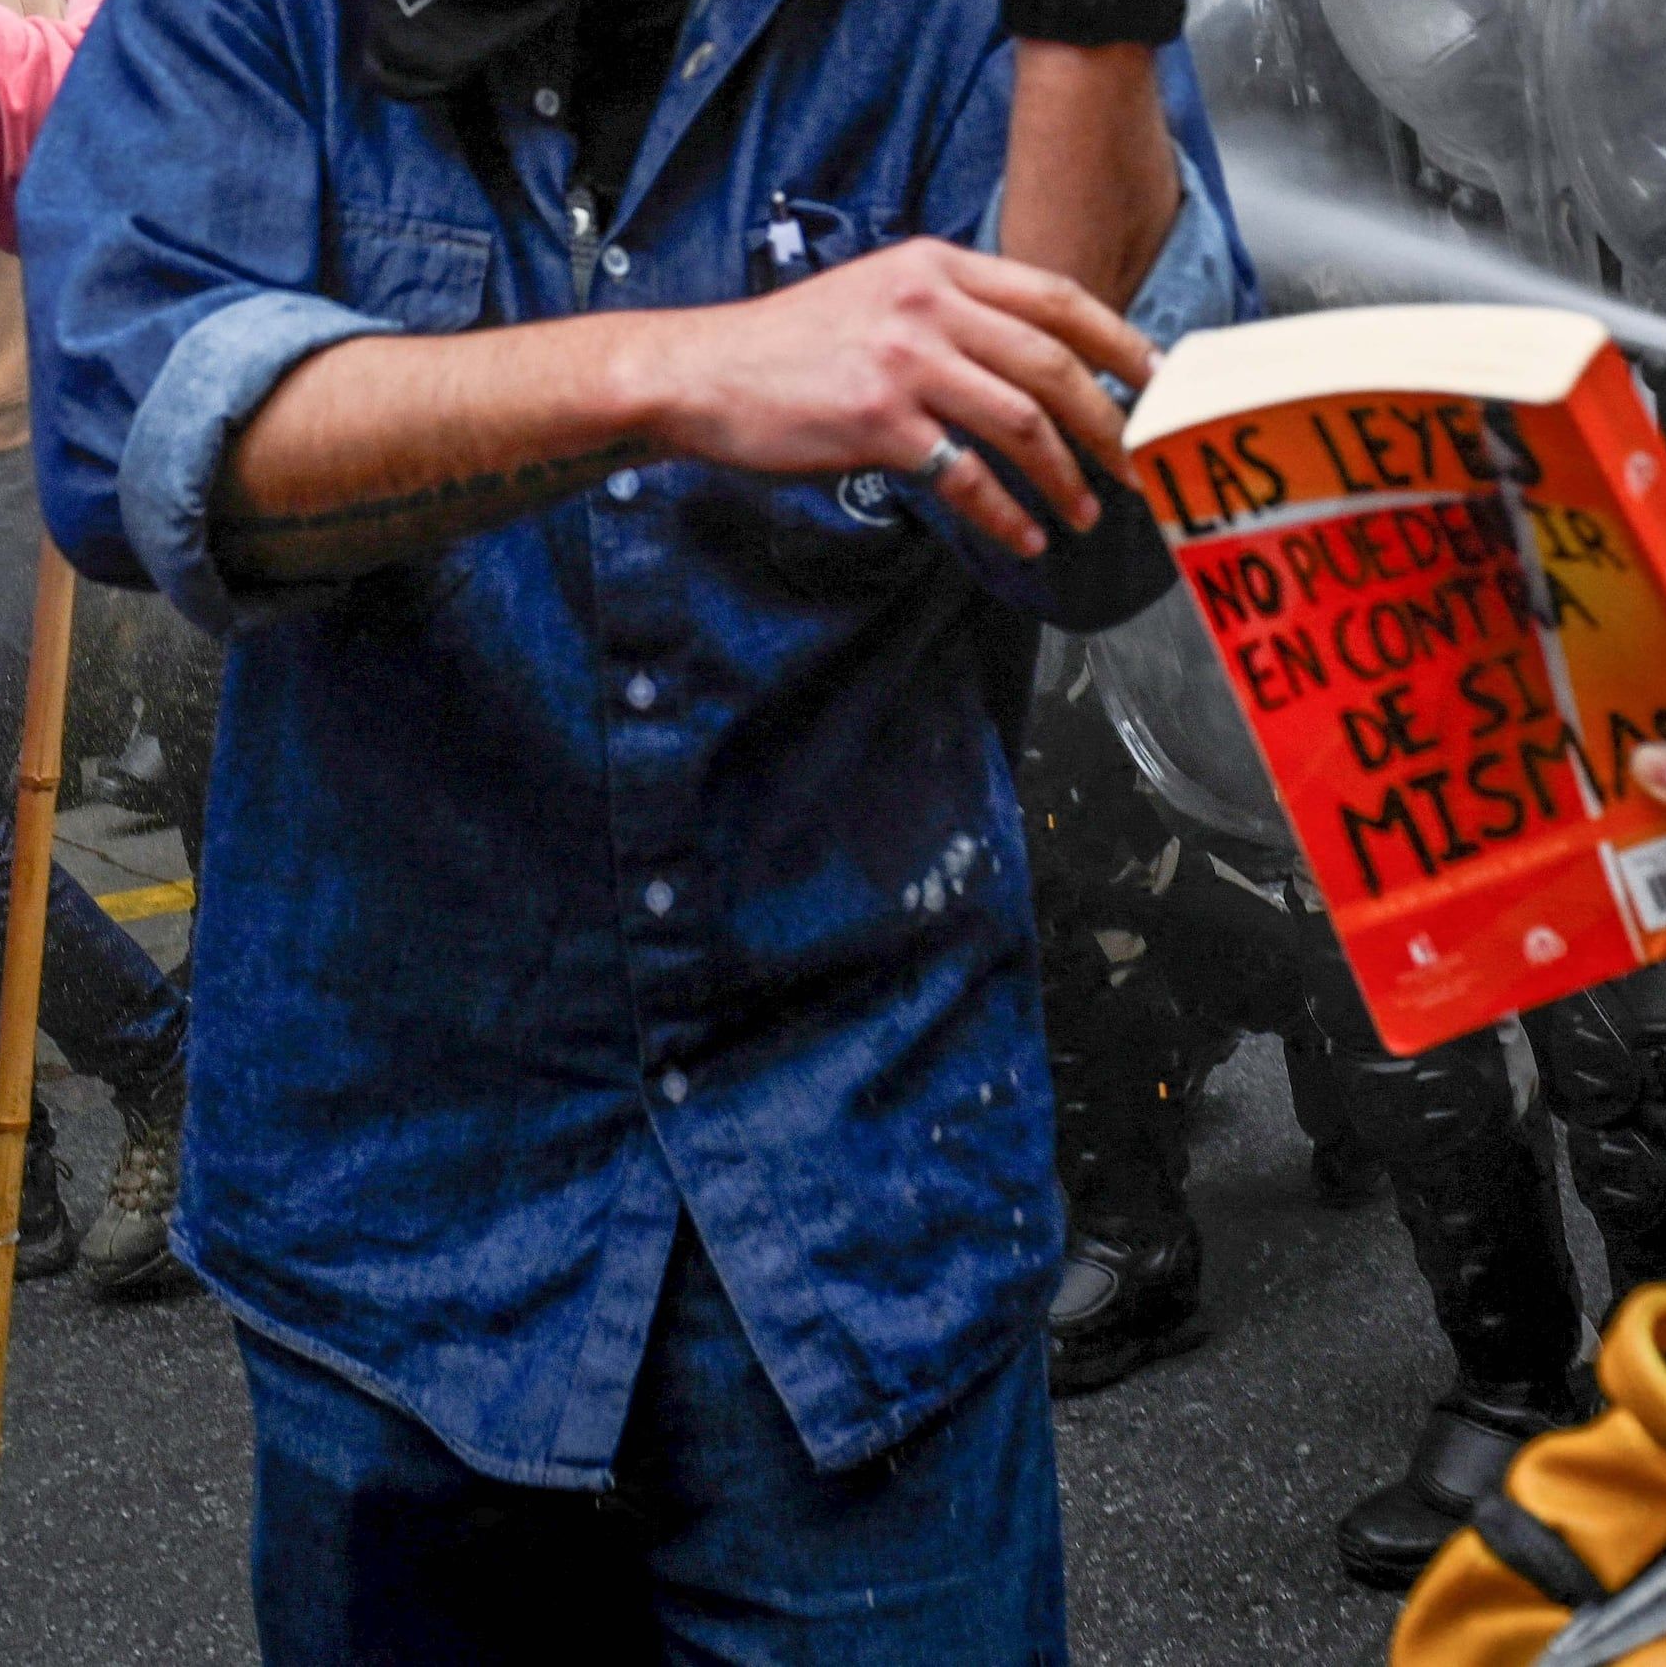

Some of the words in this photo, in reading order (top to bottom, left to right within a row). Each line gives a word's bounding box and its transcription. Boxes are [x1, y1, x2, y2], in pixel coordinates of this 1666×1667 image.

[1153, 425, 1288, 536] LAS
[1311, 397, 1546, 497] LEYES
[1196, 551, 1282, 631] NO
[1235, 626, 1329, 712] EN
[1341, 683, 1440, 771] DE
